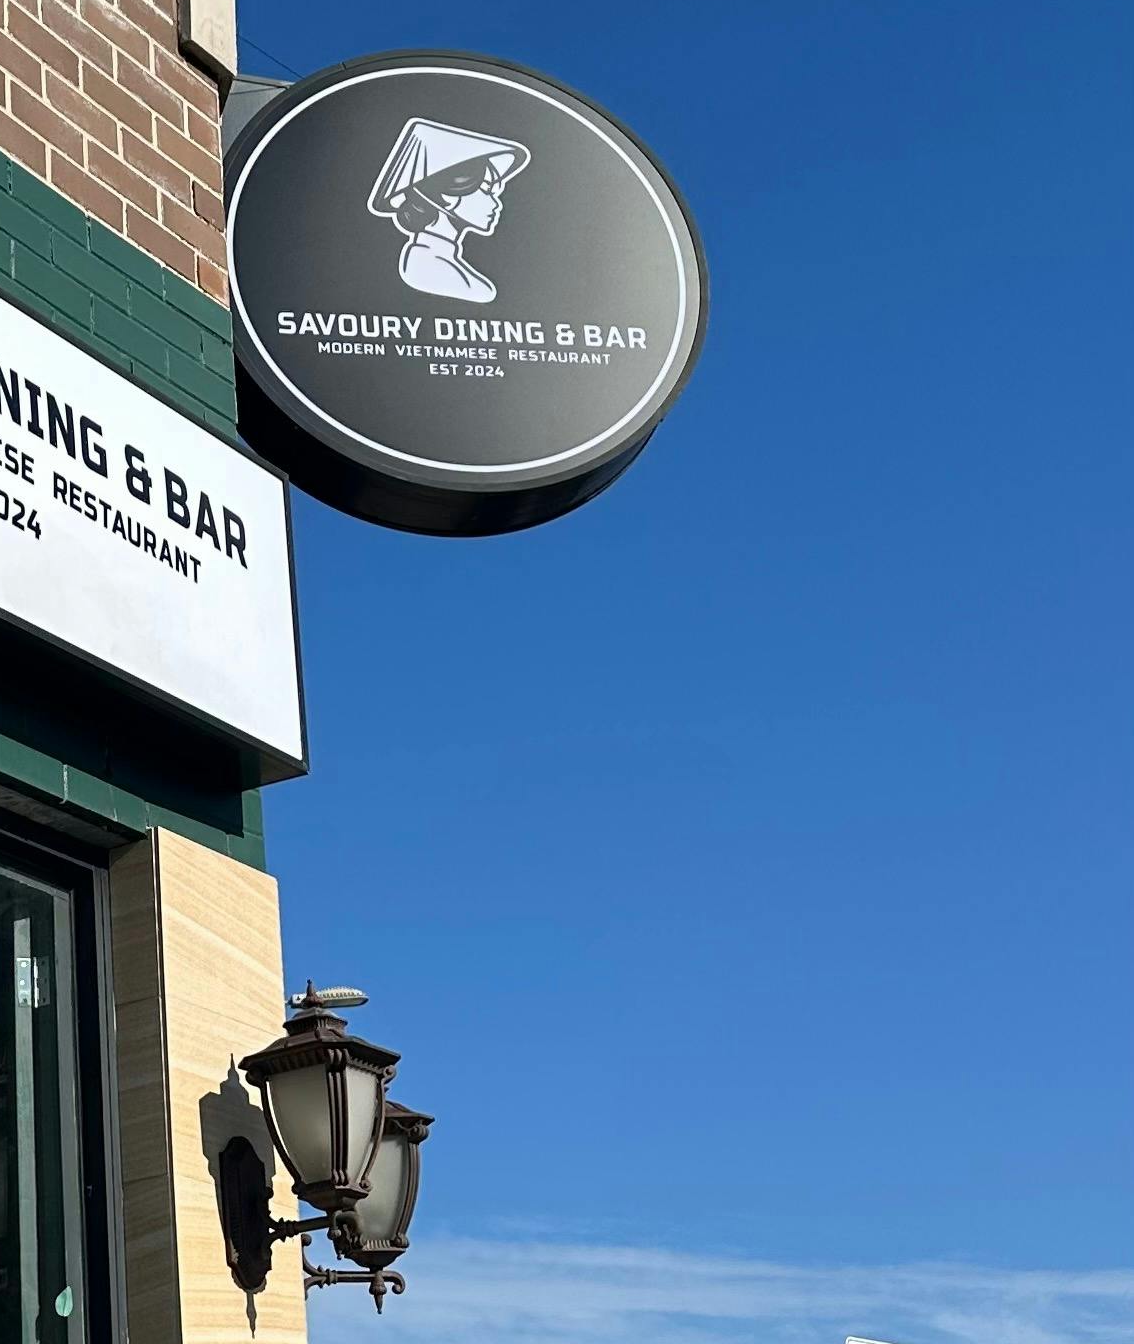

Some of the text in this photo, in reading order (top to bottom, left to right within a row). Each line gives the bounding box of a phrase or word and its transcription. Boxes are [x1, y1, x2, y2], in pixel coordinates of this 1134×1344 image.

[277, 311, 647, 350] SAVOURY DINING & BAR
[317, 341, 611, 366] MODERN VIETNAMESE RESTAURANT
[429, 363, 505, 378] EST 2024
[124, 444, 153, 506] &
[163, 466, 248, 570] BAR
[53, 471, 202, 584] RESTAURANT
